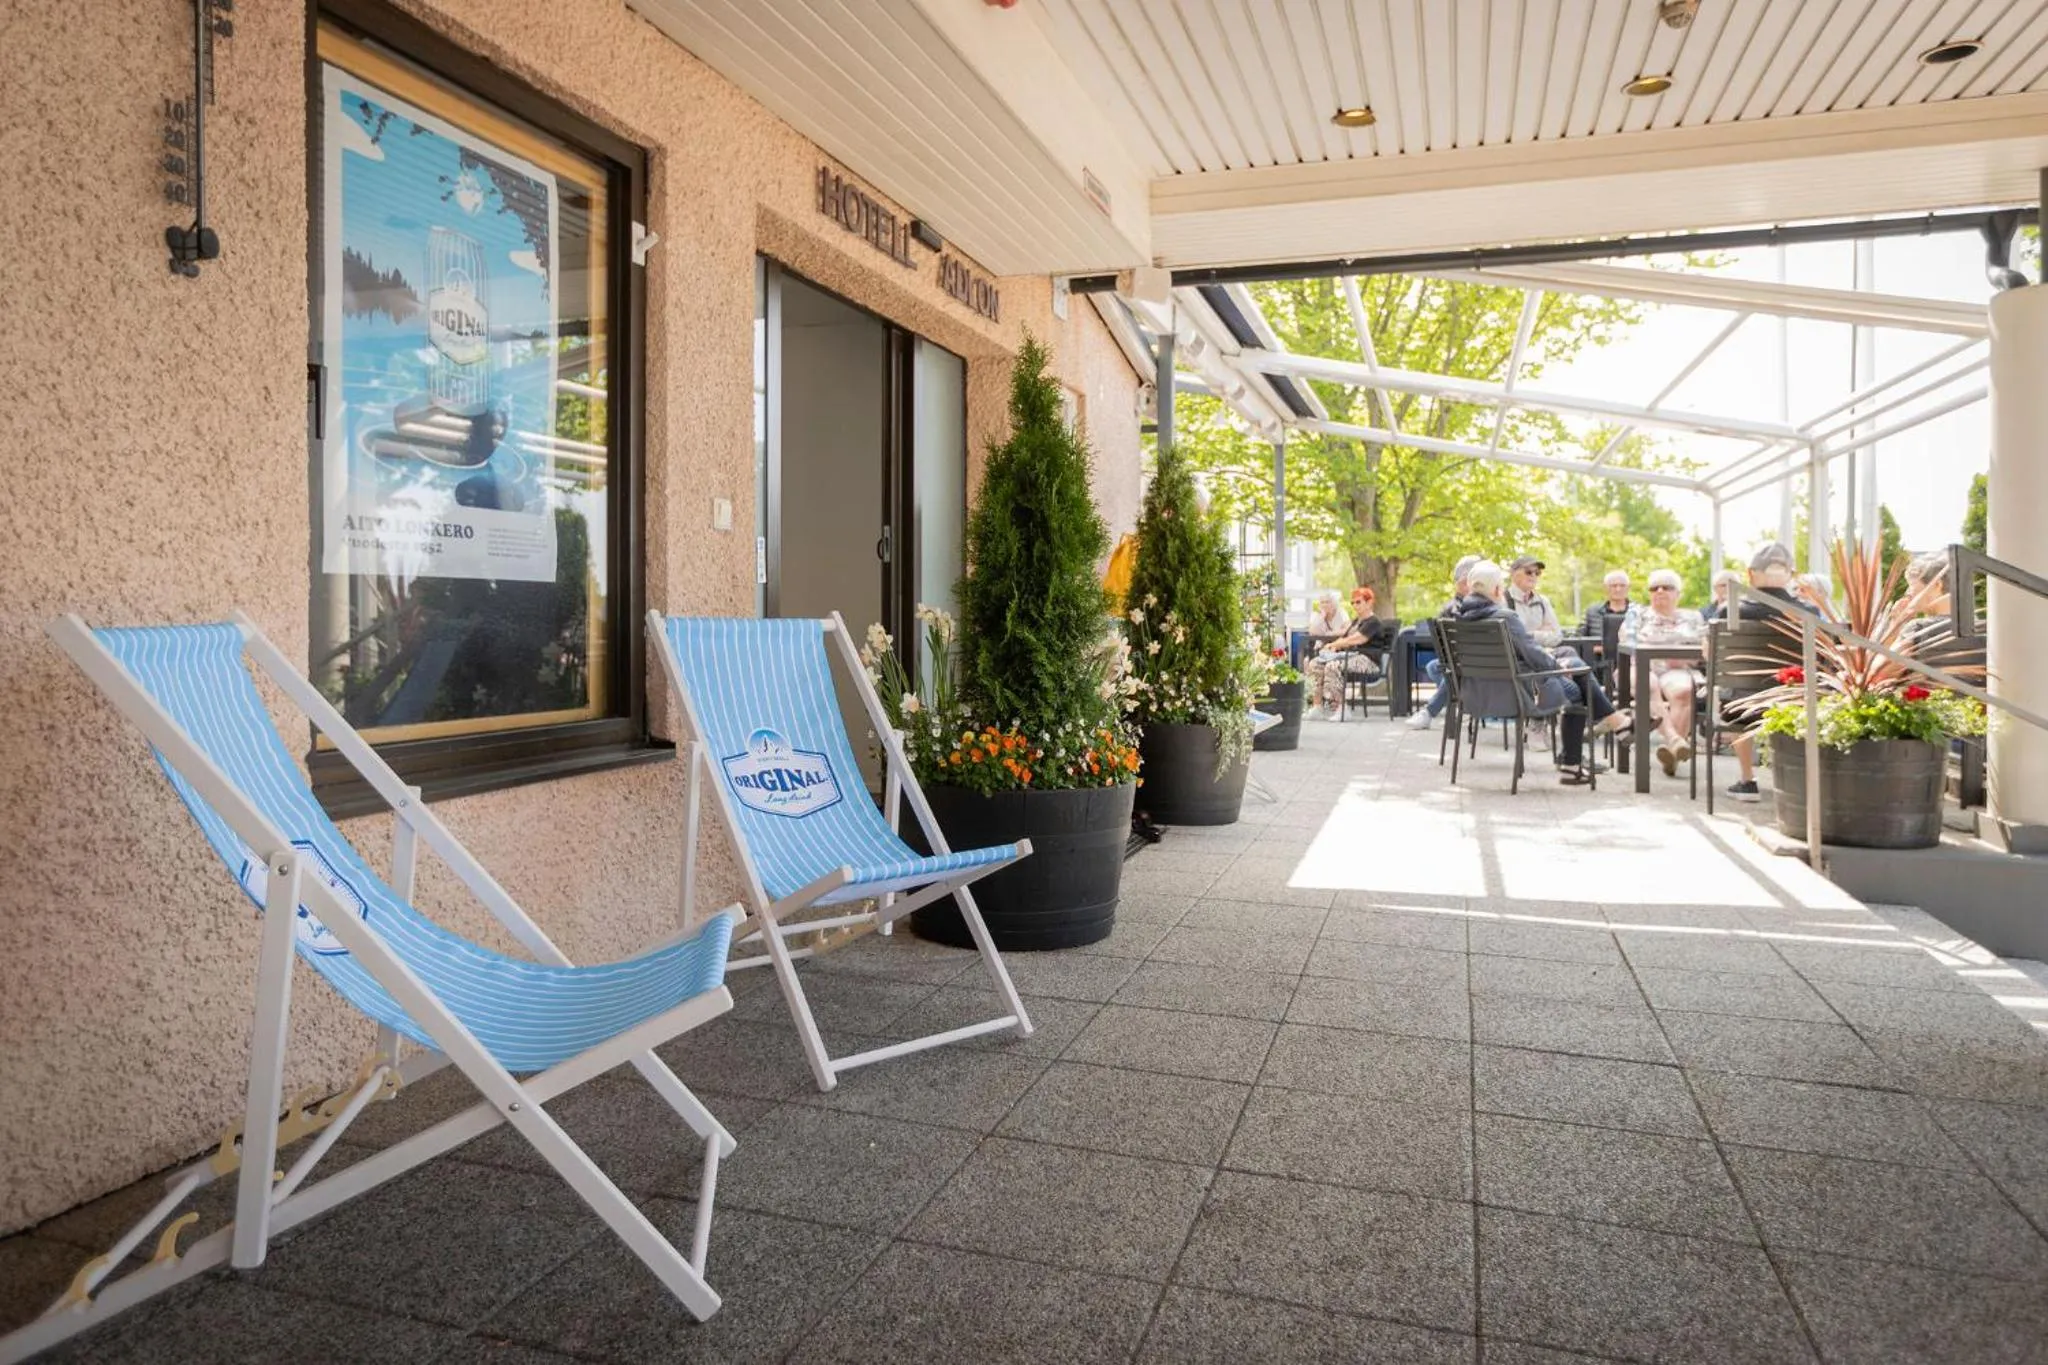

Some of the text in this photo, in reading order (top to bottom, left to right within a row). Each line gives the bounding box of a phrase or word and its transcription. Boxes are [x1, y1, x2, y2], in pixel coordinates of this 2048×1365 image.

[817, 166, 917, 270] HOTELL
[342, 514, 474, 539] AITO LONKERO
[734, 768, 825, 792] ORIGINAL
